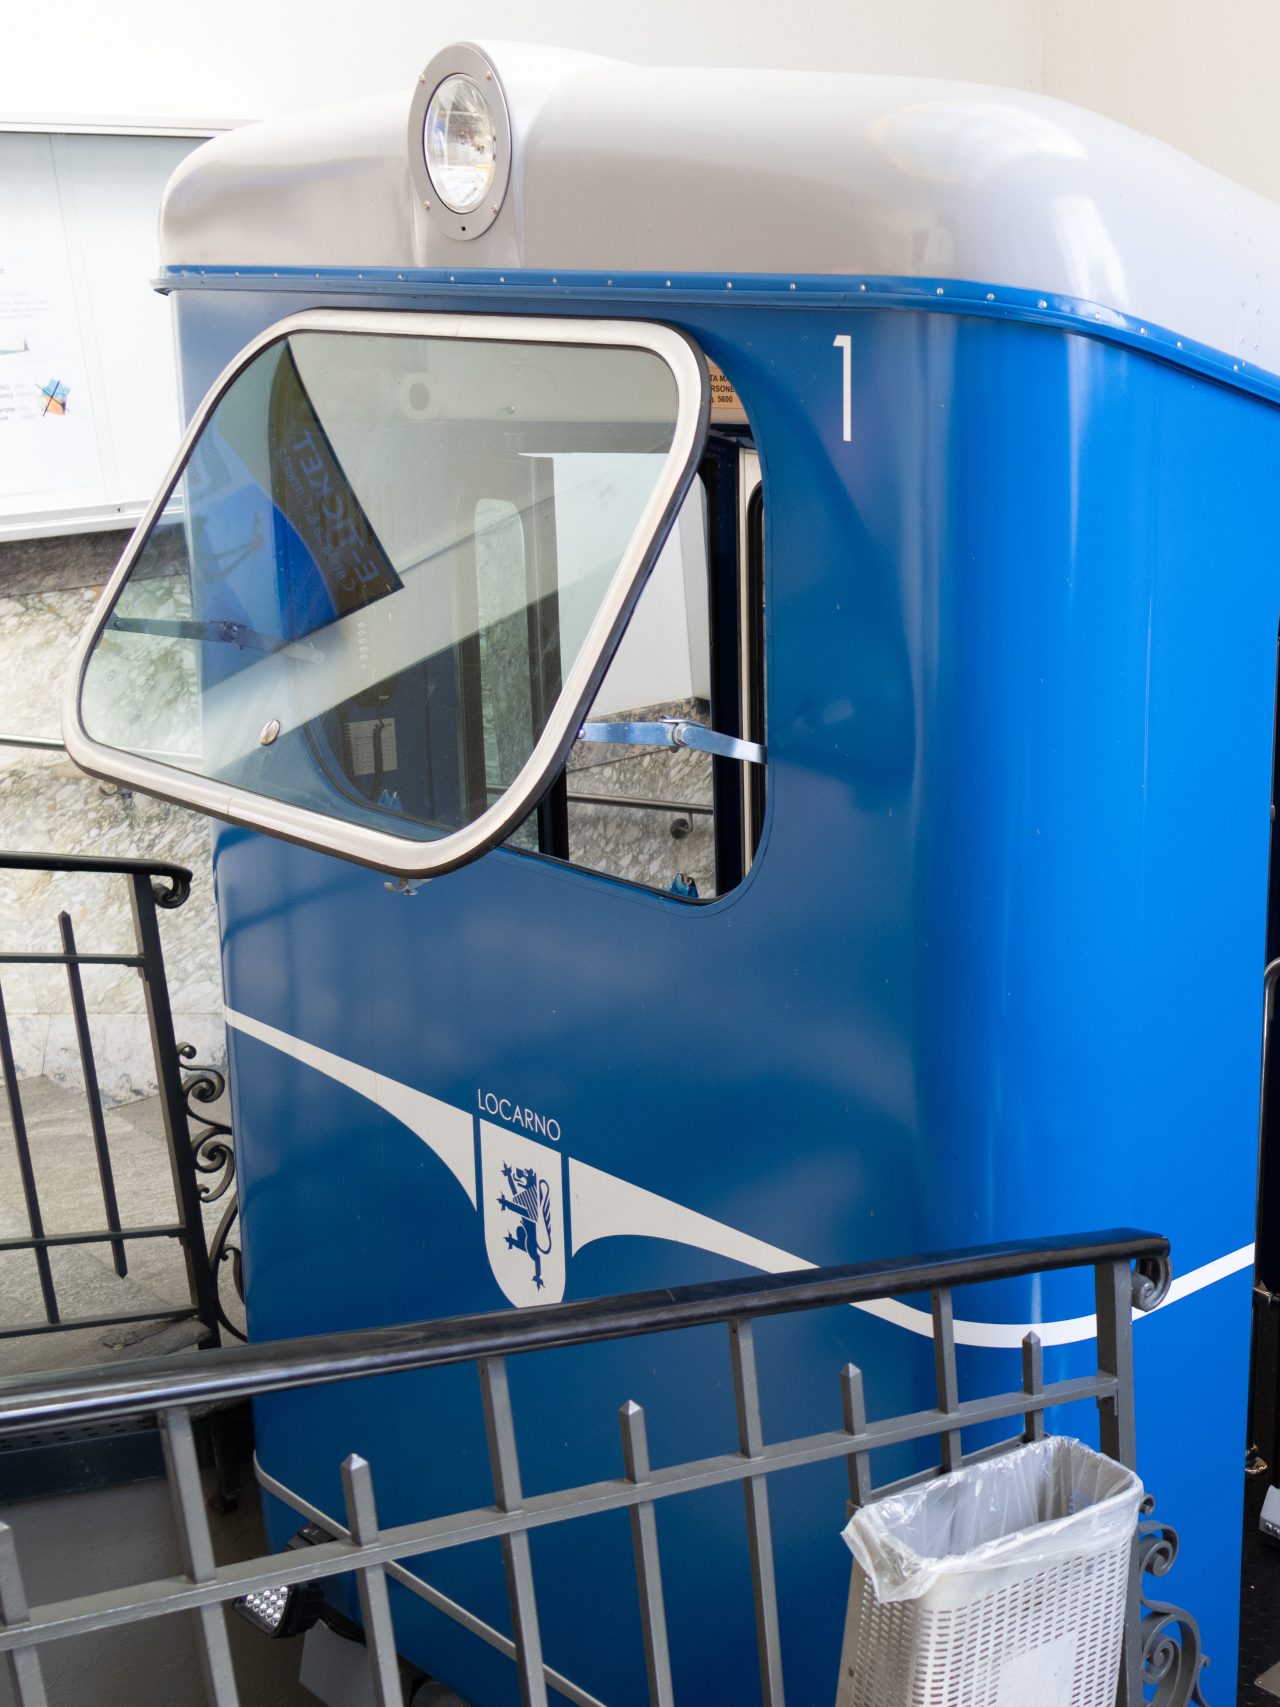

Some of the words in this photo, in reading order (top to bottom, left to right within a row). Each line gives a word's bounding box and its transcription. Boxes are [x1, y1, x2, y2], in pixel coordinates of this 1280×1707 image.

[717, 395, 733, 403] 5600
[832, 334, 852, 442] 1
[477, 1088, 561, 1141] LOCARNO
